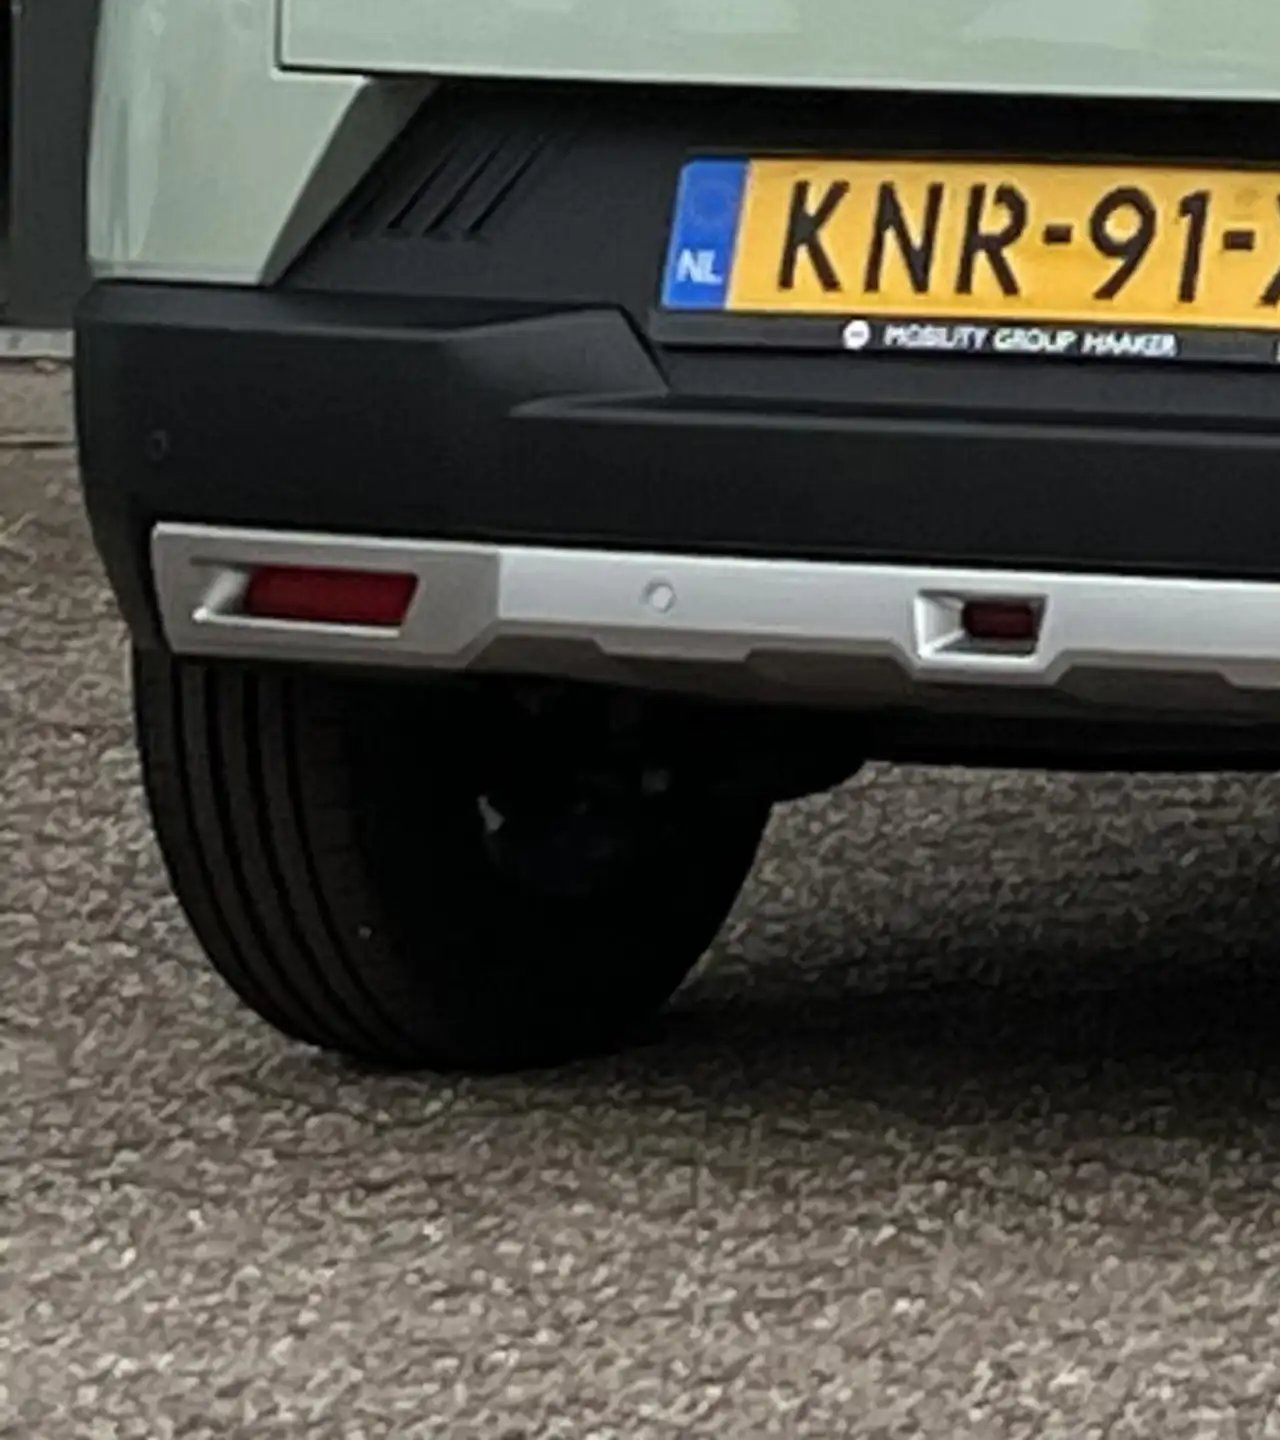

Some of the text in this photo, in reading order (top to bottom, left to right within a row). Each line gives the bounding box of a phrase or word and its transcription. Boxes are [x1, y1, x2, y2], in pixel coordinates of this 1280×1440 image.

[676, 249, 723, 285] NL
[883, 323, 987, 350] MOBILITY
[993, 327, 1078, 353] GROUP
